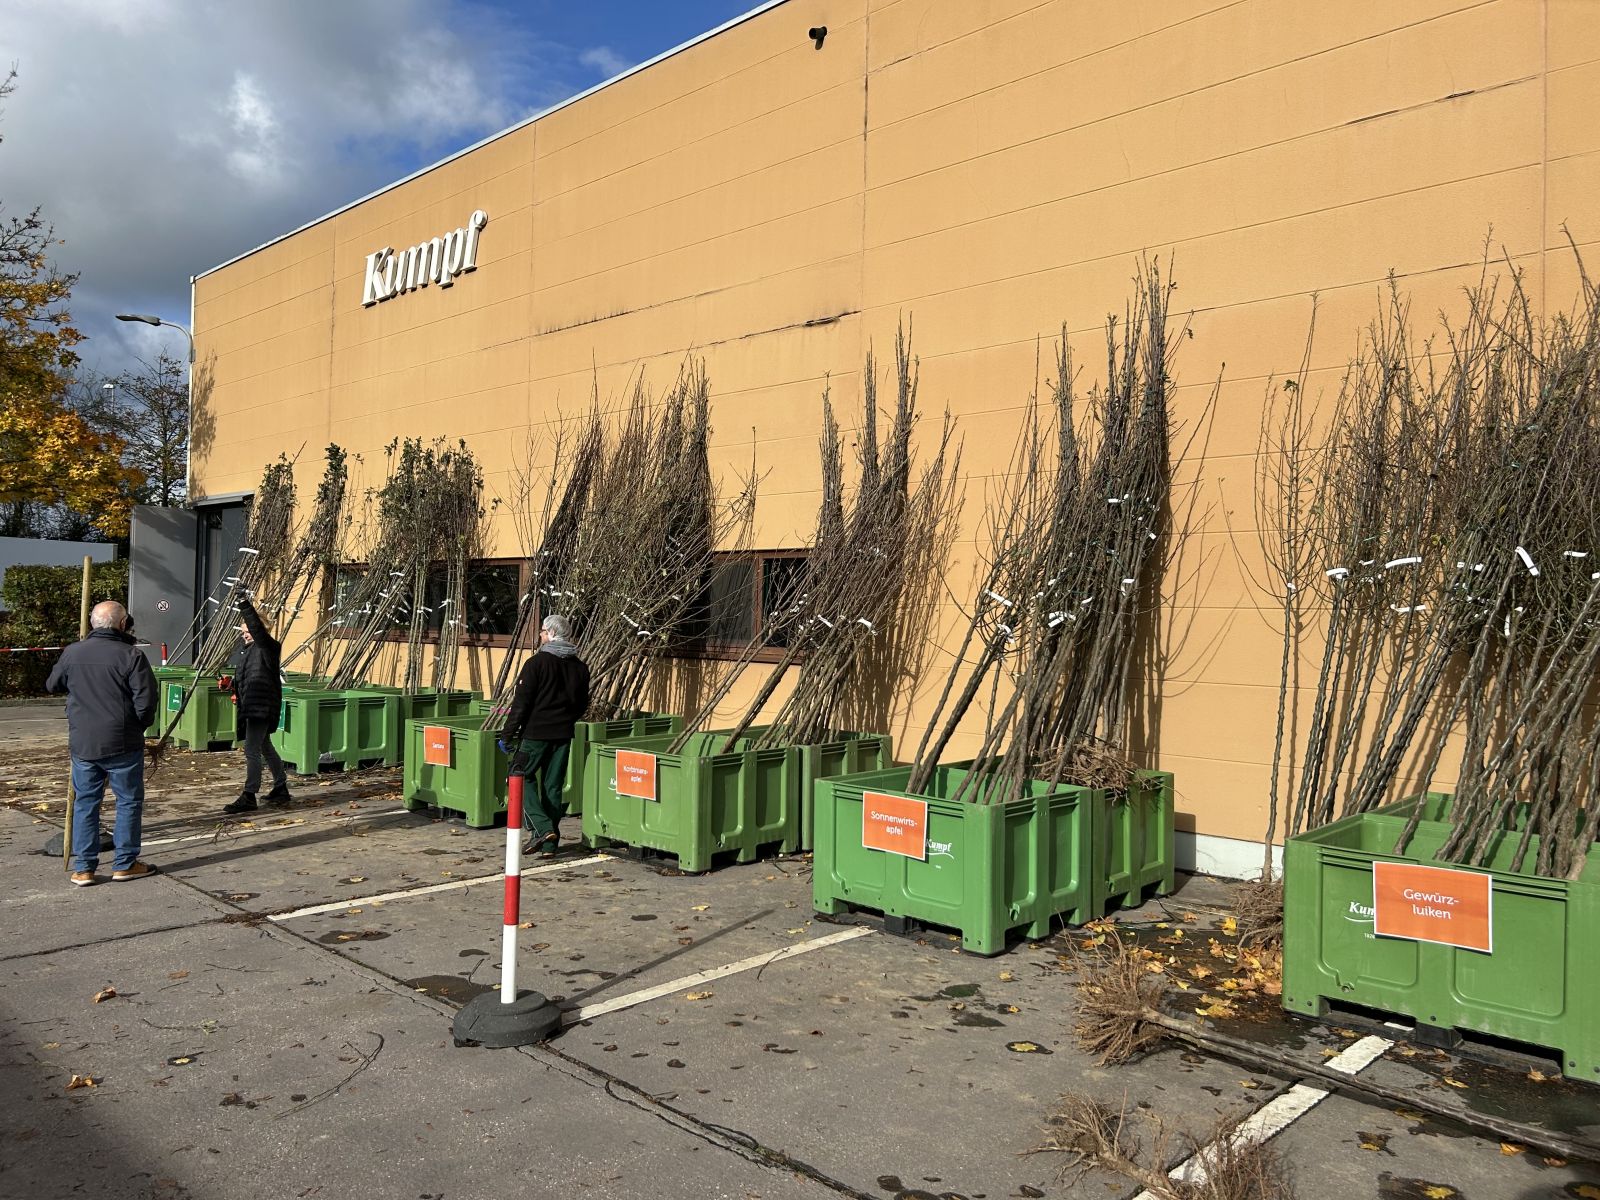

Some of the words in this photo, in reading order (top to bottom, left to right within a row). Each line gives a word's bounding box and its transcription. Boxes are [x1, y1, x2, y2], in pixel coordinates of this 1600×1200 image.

[360, 209, 488, 307] Kumpf
[870, 810, 918, 827] Sonnenwirts-
[886, 826, 903, 835] apfel
[925, 838, 952, 853] Kumpf
[1403, 888, 1459, 906] Gewürz-
[1412, 903, 1451, 919] luiken
